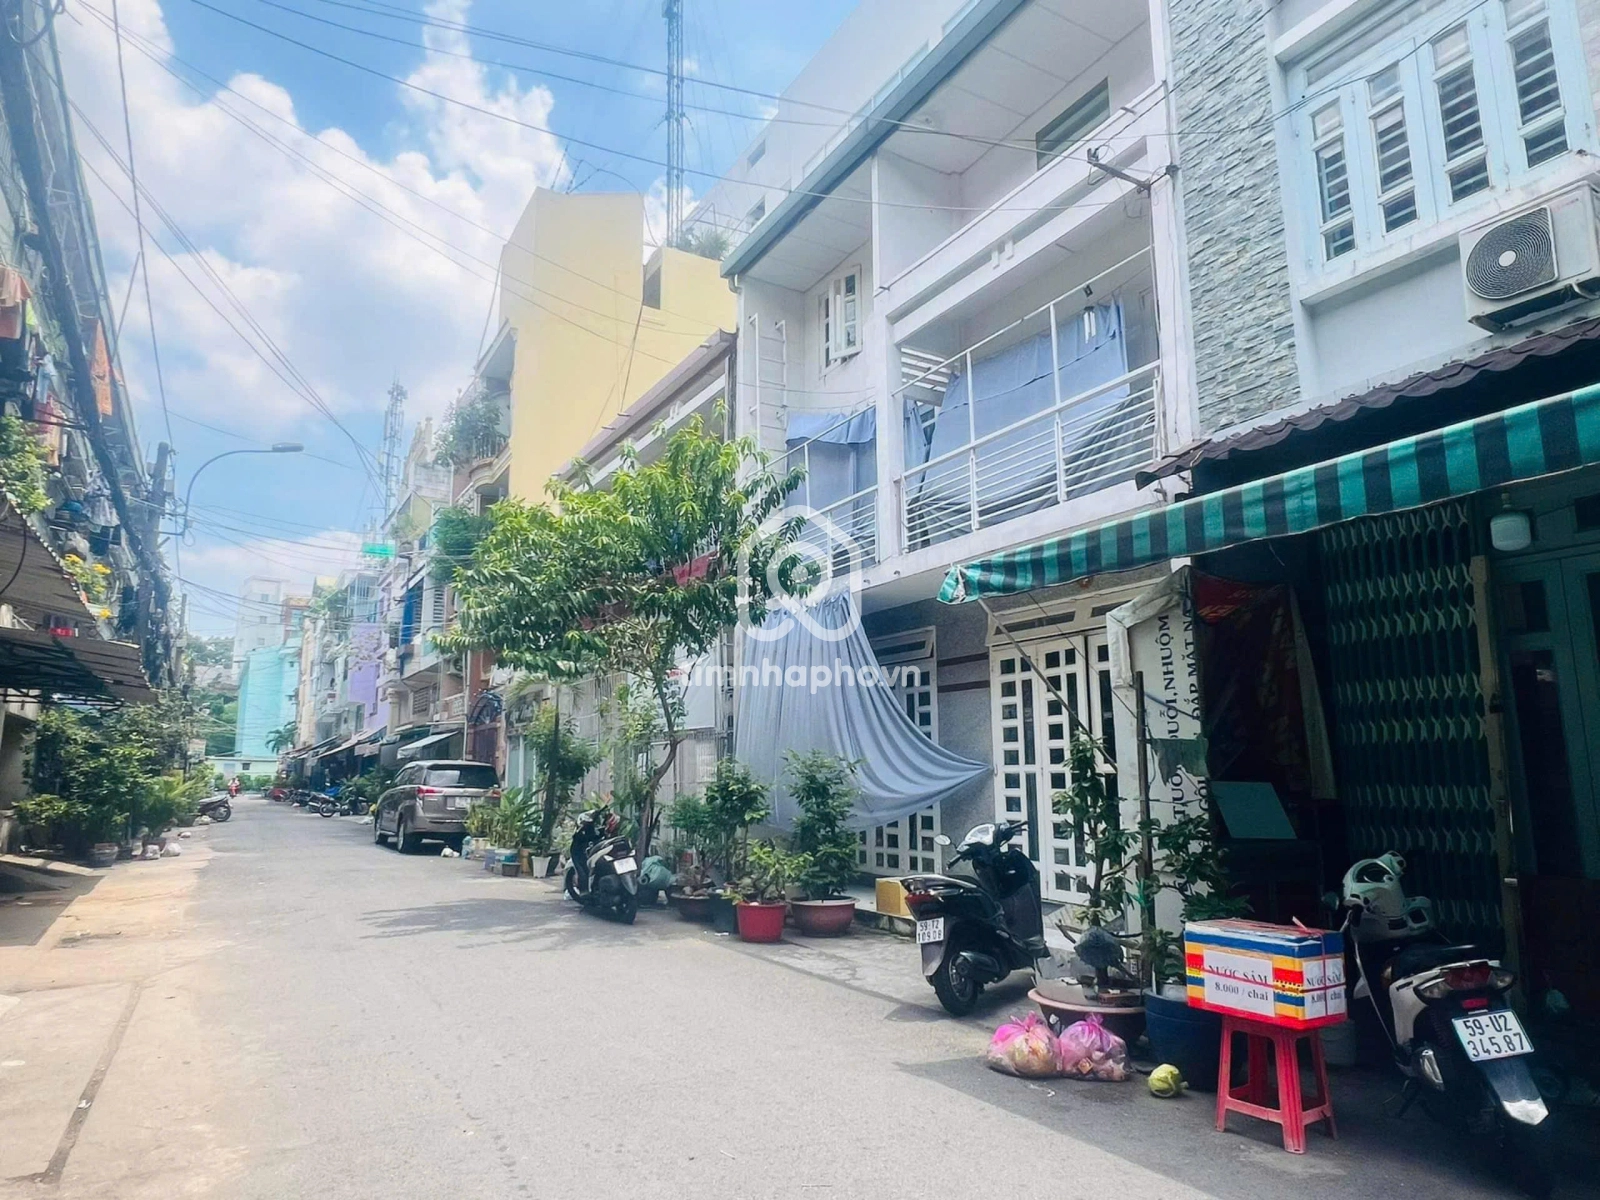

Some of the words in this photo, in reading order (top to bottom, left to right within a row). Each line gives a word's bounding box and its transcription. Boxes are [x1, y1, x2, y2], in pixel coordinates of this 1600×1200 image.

[1215, 981, 1239, 995] 8.000
[1247, 989, 1269, 1001] chai
[1463, 1014, 1512, 1037] 59-U2
[1467, 1032, 1524, 1058] 345.87
